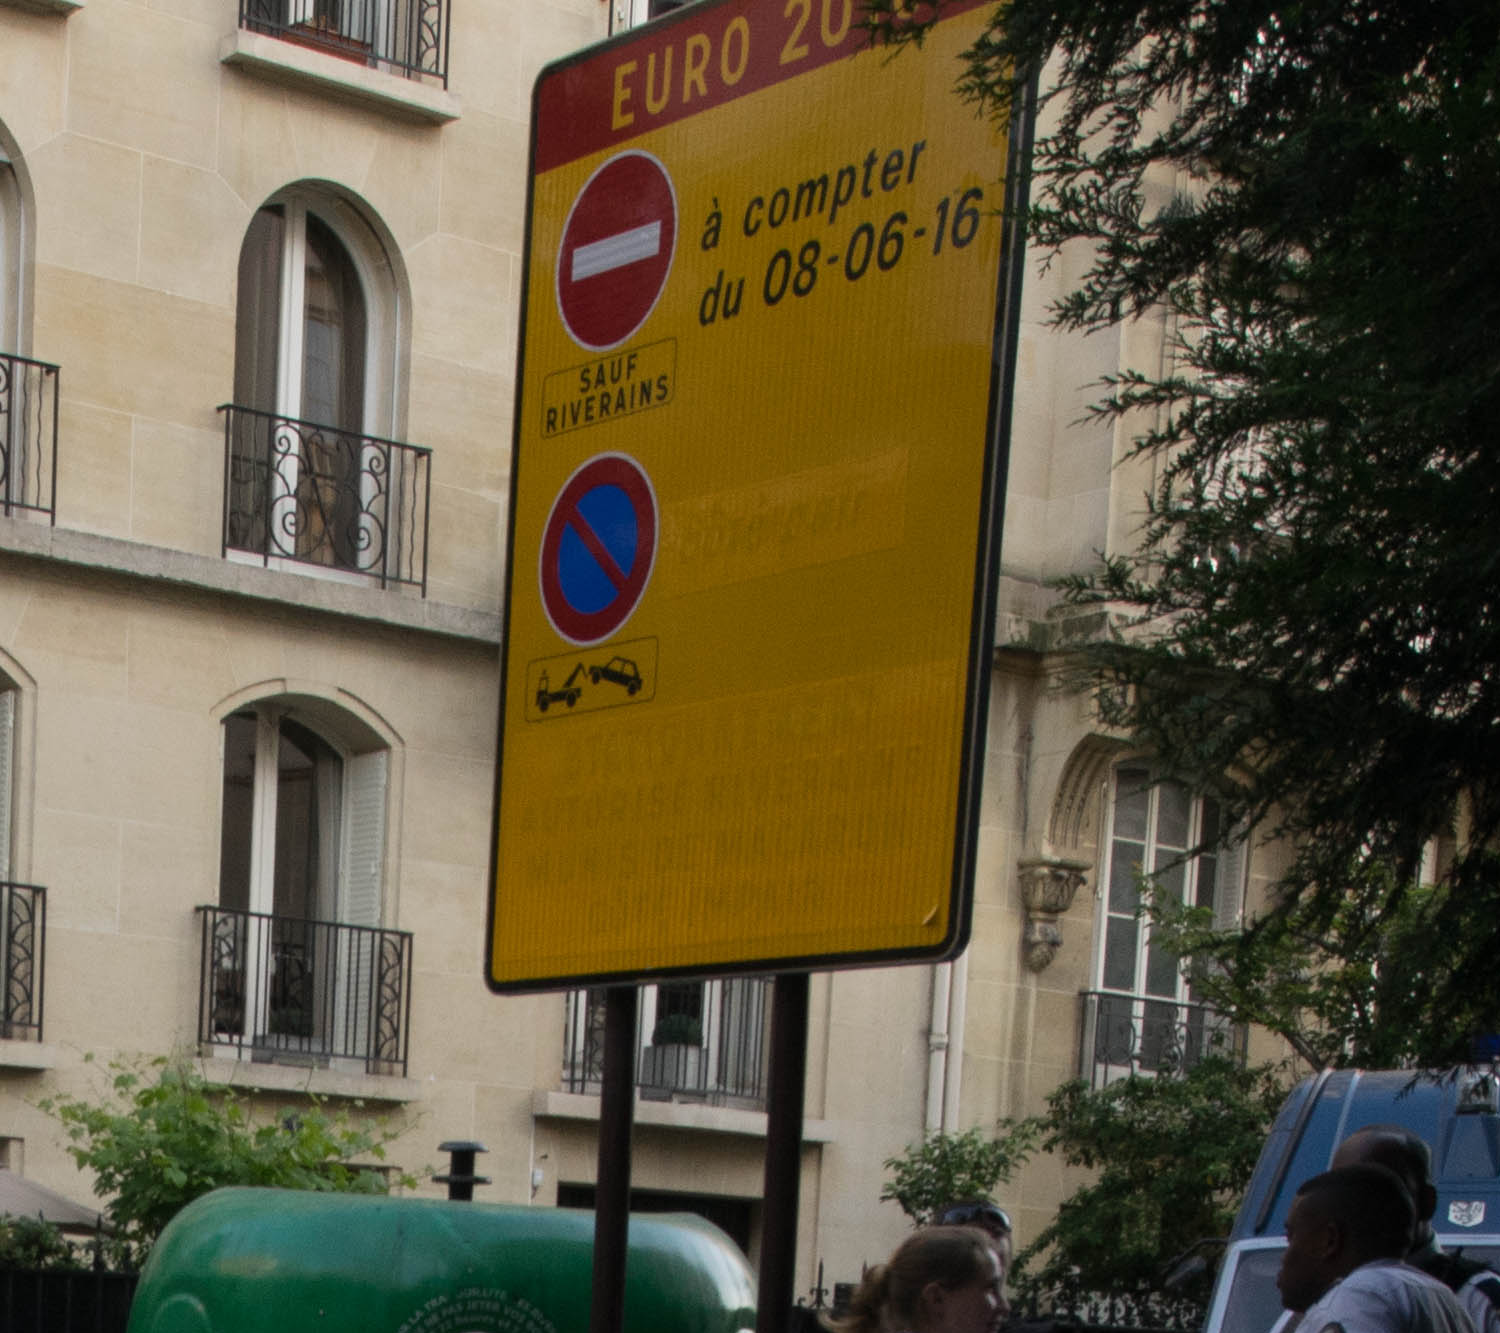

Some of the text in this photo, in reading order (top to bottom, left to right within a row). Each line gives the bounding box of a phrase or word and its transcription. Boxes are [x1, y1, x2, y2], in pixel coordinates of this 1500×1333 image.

[611, 0, 914, 132] EURO 20
[700, 139, 927, 252] à compter
[699, 187, 984, 326] du 08-06-16
[545, 375, 669, 433] RIVERAINS
[579, 353, 639, 394] SAUF
